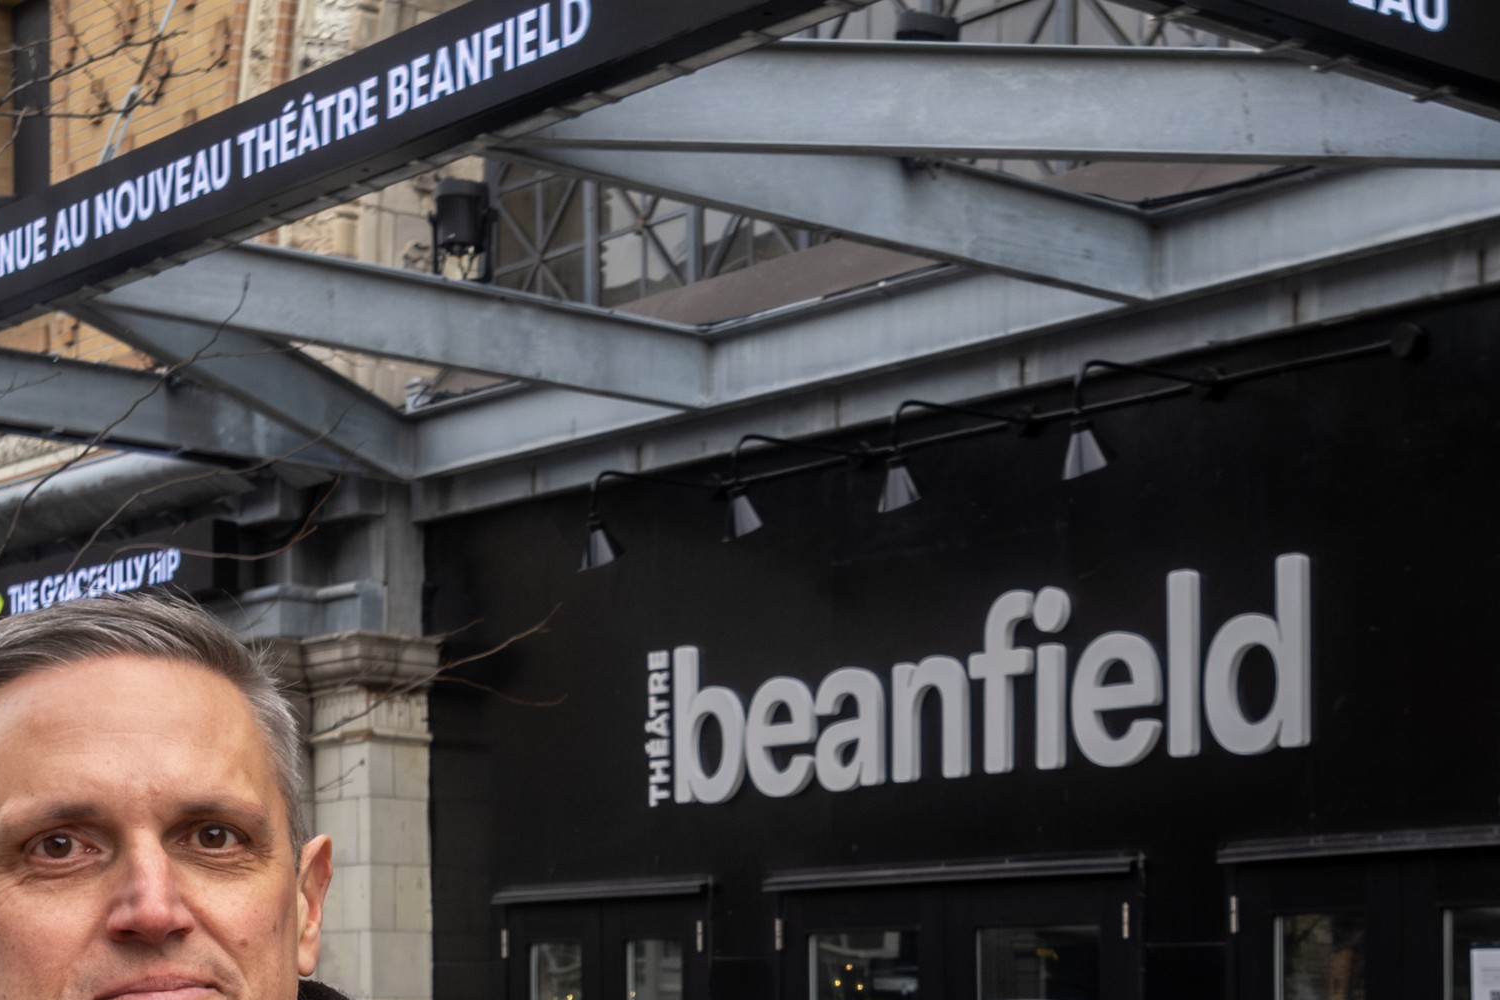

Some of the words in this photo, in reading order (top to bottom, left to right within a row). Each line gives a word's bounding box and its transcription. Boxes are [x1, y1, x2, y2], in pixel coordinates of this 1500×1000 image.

[1348, 0, 1449, 32] AU
[52, 194, 88, 257] AU
[94, 138, 232, 239] NOUVEAU
[236, 76, 379, 179] THÉÂTRE
[386, 0, 592, 119] BEANFIELD
[7, 579, 40, 615] THE
[148, 547, 181, 586] HIP
[644, 650, 671, 808] THÉÂTRE
[673, 552, 1311, 804] beanfield
